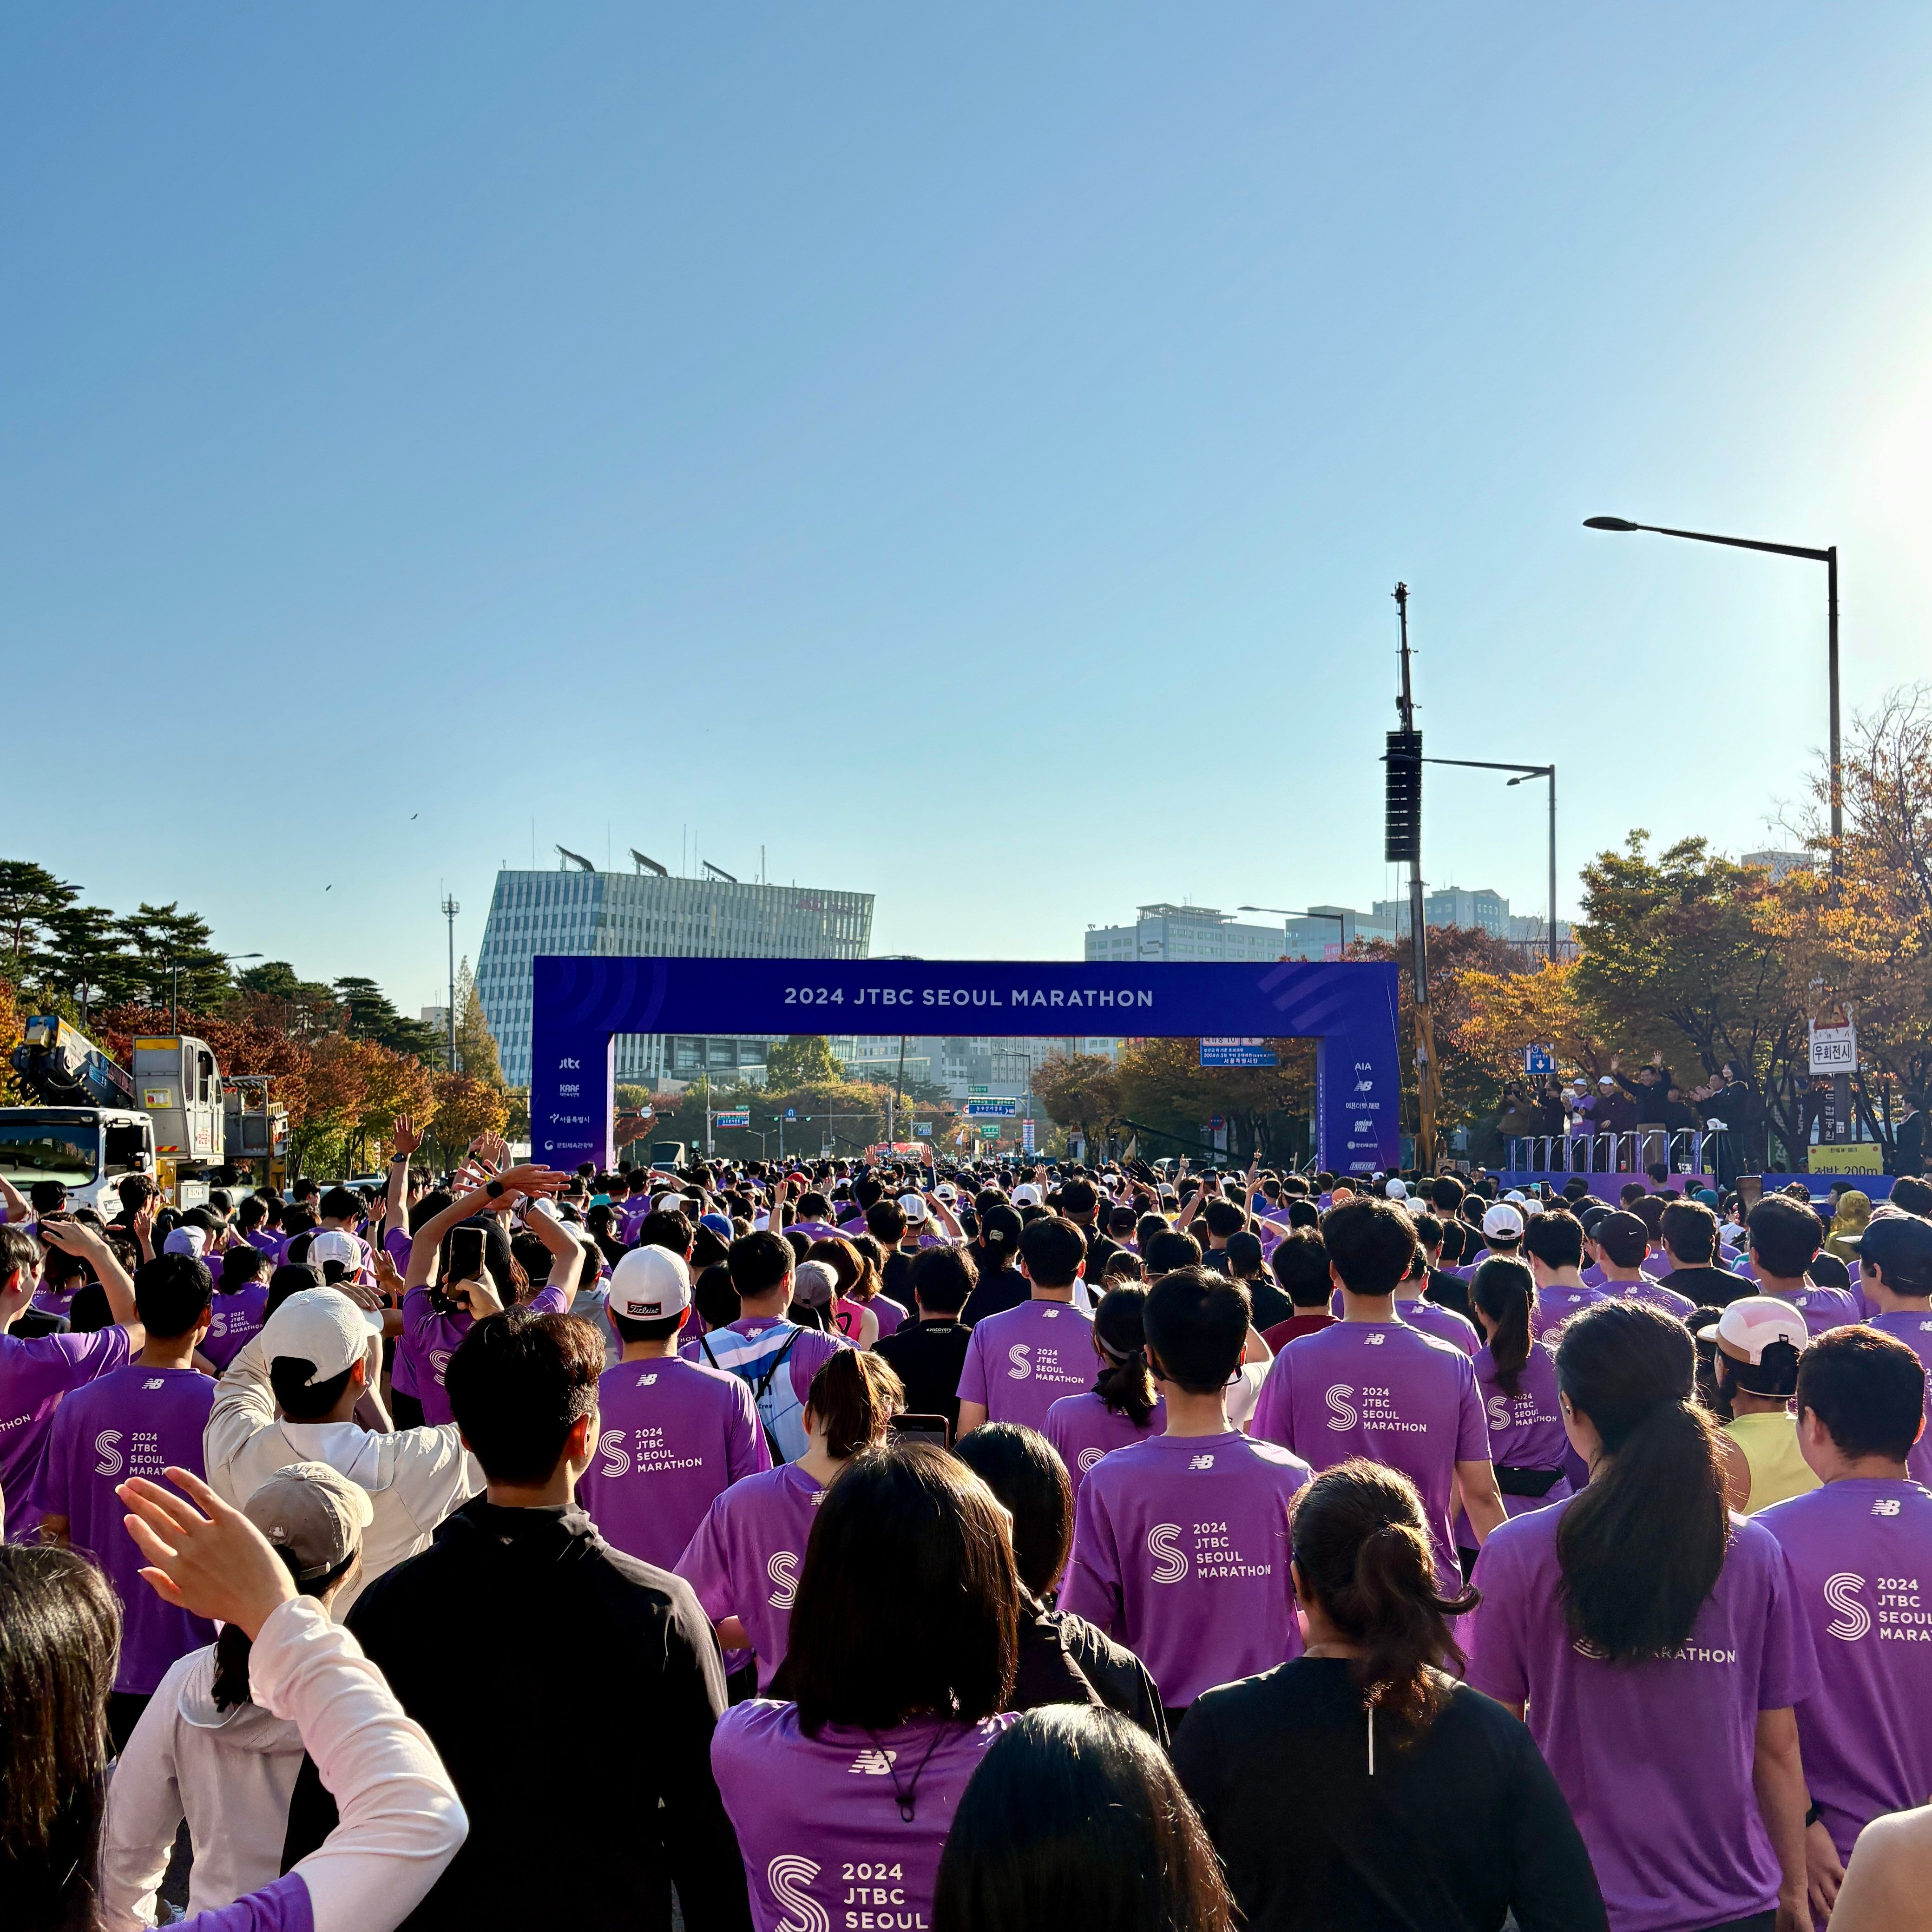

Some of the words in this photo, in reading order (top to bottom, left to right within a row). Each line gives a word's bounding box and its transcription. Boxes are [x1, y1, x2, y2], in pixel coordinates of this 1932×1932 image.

[785, 988, 843, 1004] 2024
[854, 989, 913, 1005] JTBC
[923, 990, 1002, 1005] SEOUL
[1012, 990, 1152, 1006] MARATHON
[1815, 1043, 1850, 1061] 우회전시
[1036, 1365, 1064, 1373] SEOUL
[1036, 1373, 1084, 1384] MARATHON
[1363, 1387, 1389, 1396] 2024
[1514, 1401, 1534, 1410] JTBC
[1363, 1410, 1399, 1419] SEOUL
[0, 1413, 31, 1432] THON
[1363, 1421, 1426, 1433] MARATHON
[636, 1427, 662, 1438] 2024
[637, 1439, 663, 1449] JTBC
[131, 1455, 164, 1464] SEOUL
[637, 1449, 674, 1461] SEOUL
[637, 1458, 702, 1472] MARATHON
[1194, 1522, 1227, 1534] 2024
[1196, 1537, 1229, 1549] JTBC
[1197, 1551, 1243, 1563] SEOUL
[1197, 1564, 1271, 1578] MARATHON
[1877, 1578, 1919, 1590] 2024
[1878, 1595, 1920, 1608] JTBC
[1880, 1628, 1932, 1641] MARA
[842, 1863, 902, 1880] 2024
[844, 1888, 904, 1904] JTBC
[846, 1912, 928, 1929] SEOUL
